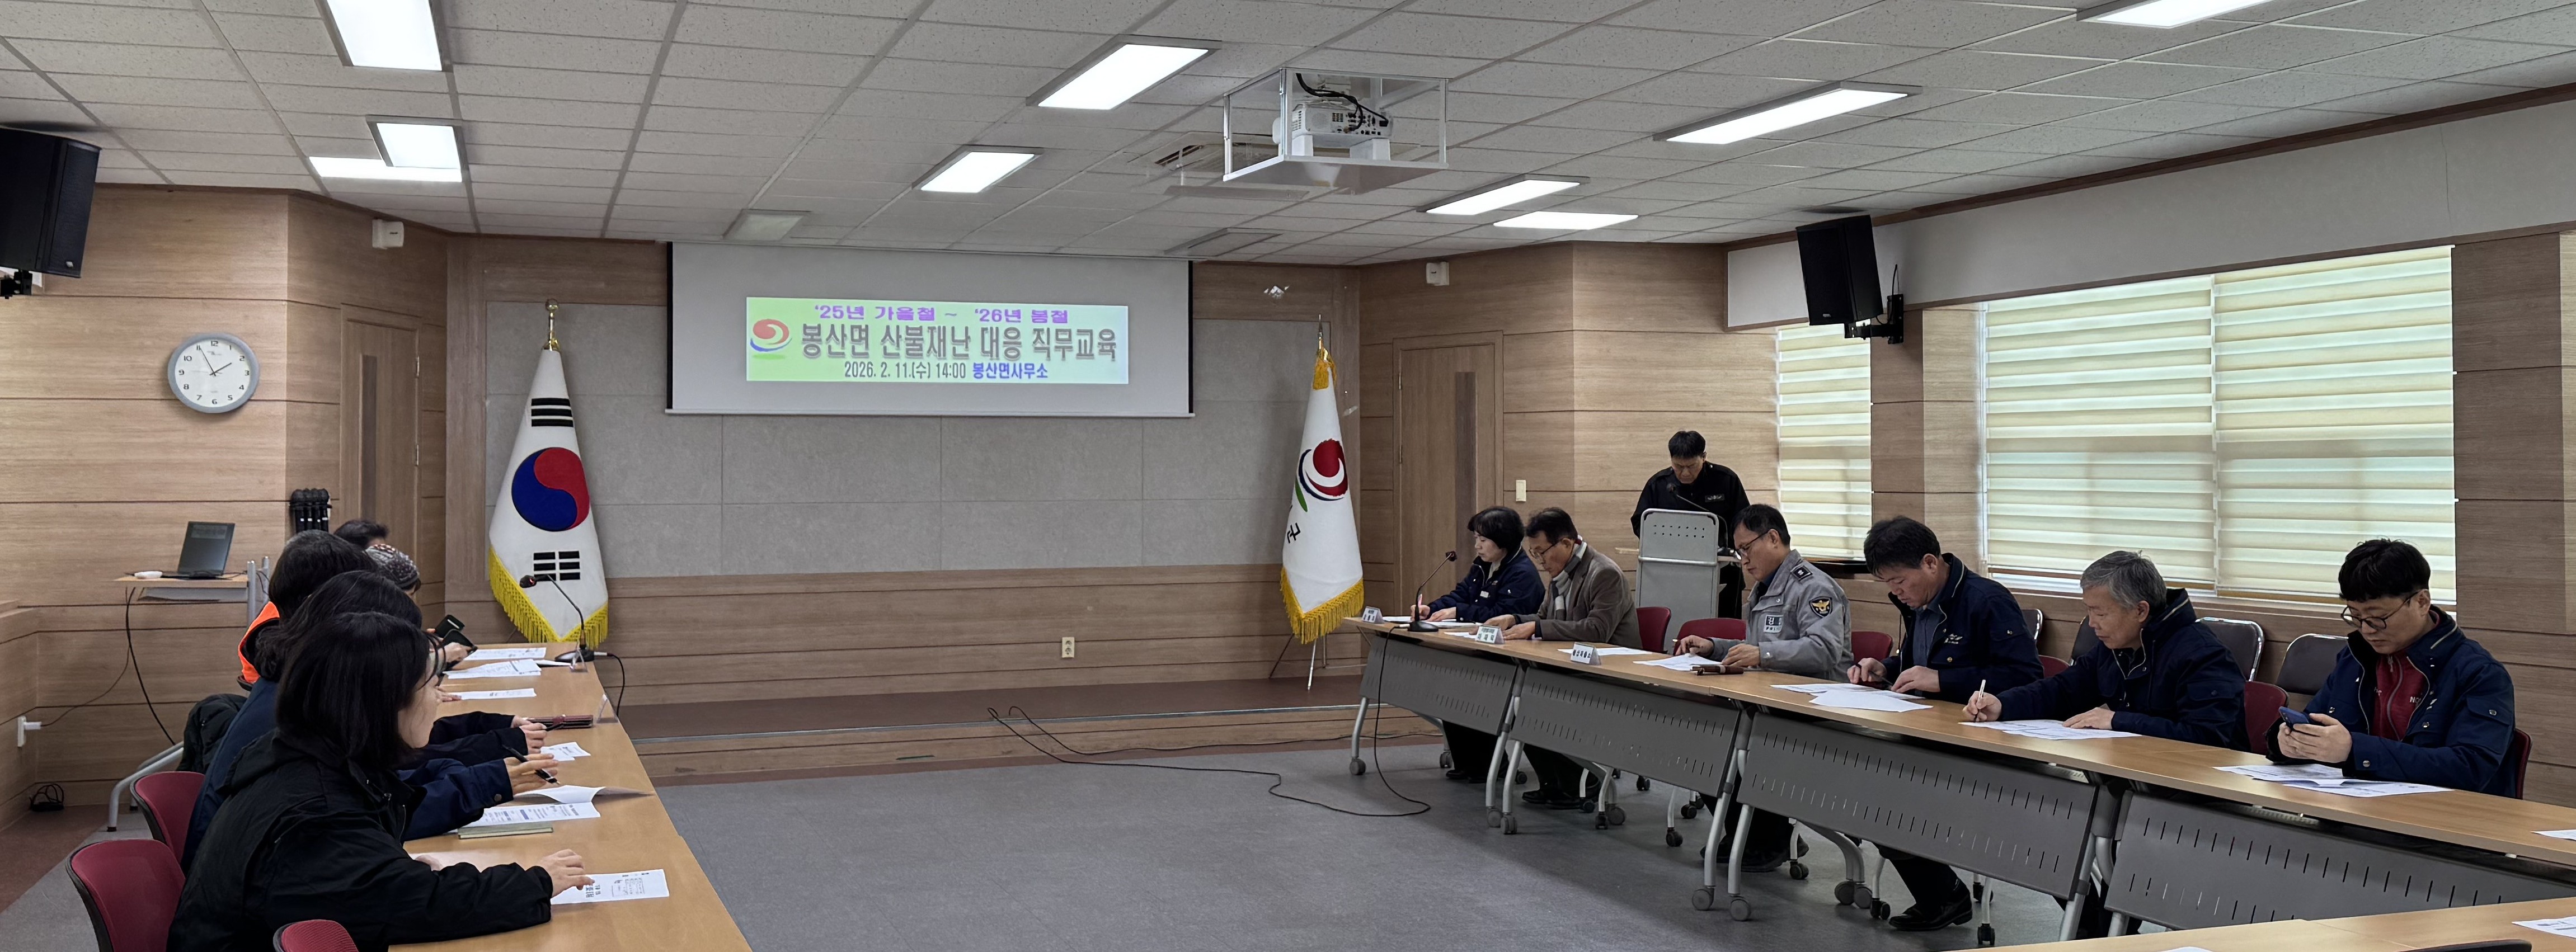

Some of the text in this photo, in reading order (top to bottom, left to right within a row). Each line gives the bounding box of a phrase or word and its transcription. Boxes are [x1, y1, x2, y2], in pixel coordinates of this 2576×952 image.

[875, 307, 935, 321] 가을철
[1031, 309, 1068, 324] 봄철
[802, 323, 1117, 360] 봉산면 산불재난 대응 직무교육
[844, 361, 876, 378] 2026.
[936, 362, 966, 379] 14:00
[972, 362, 1049, 379] 봉산면사무소
